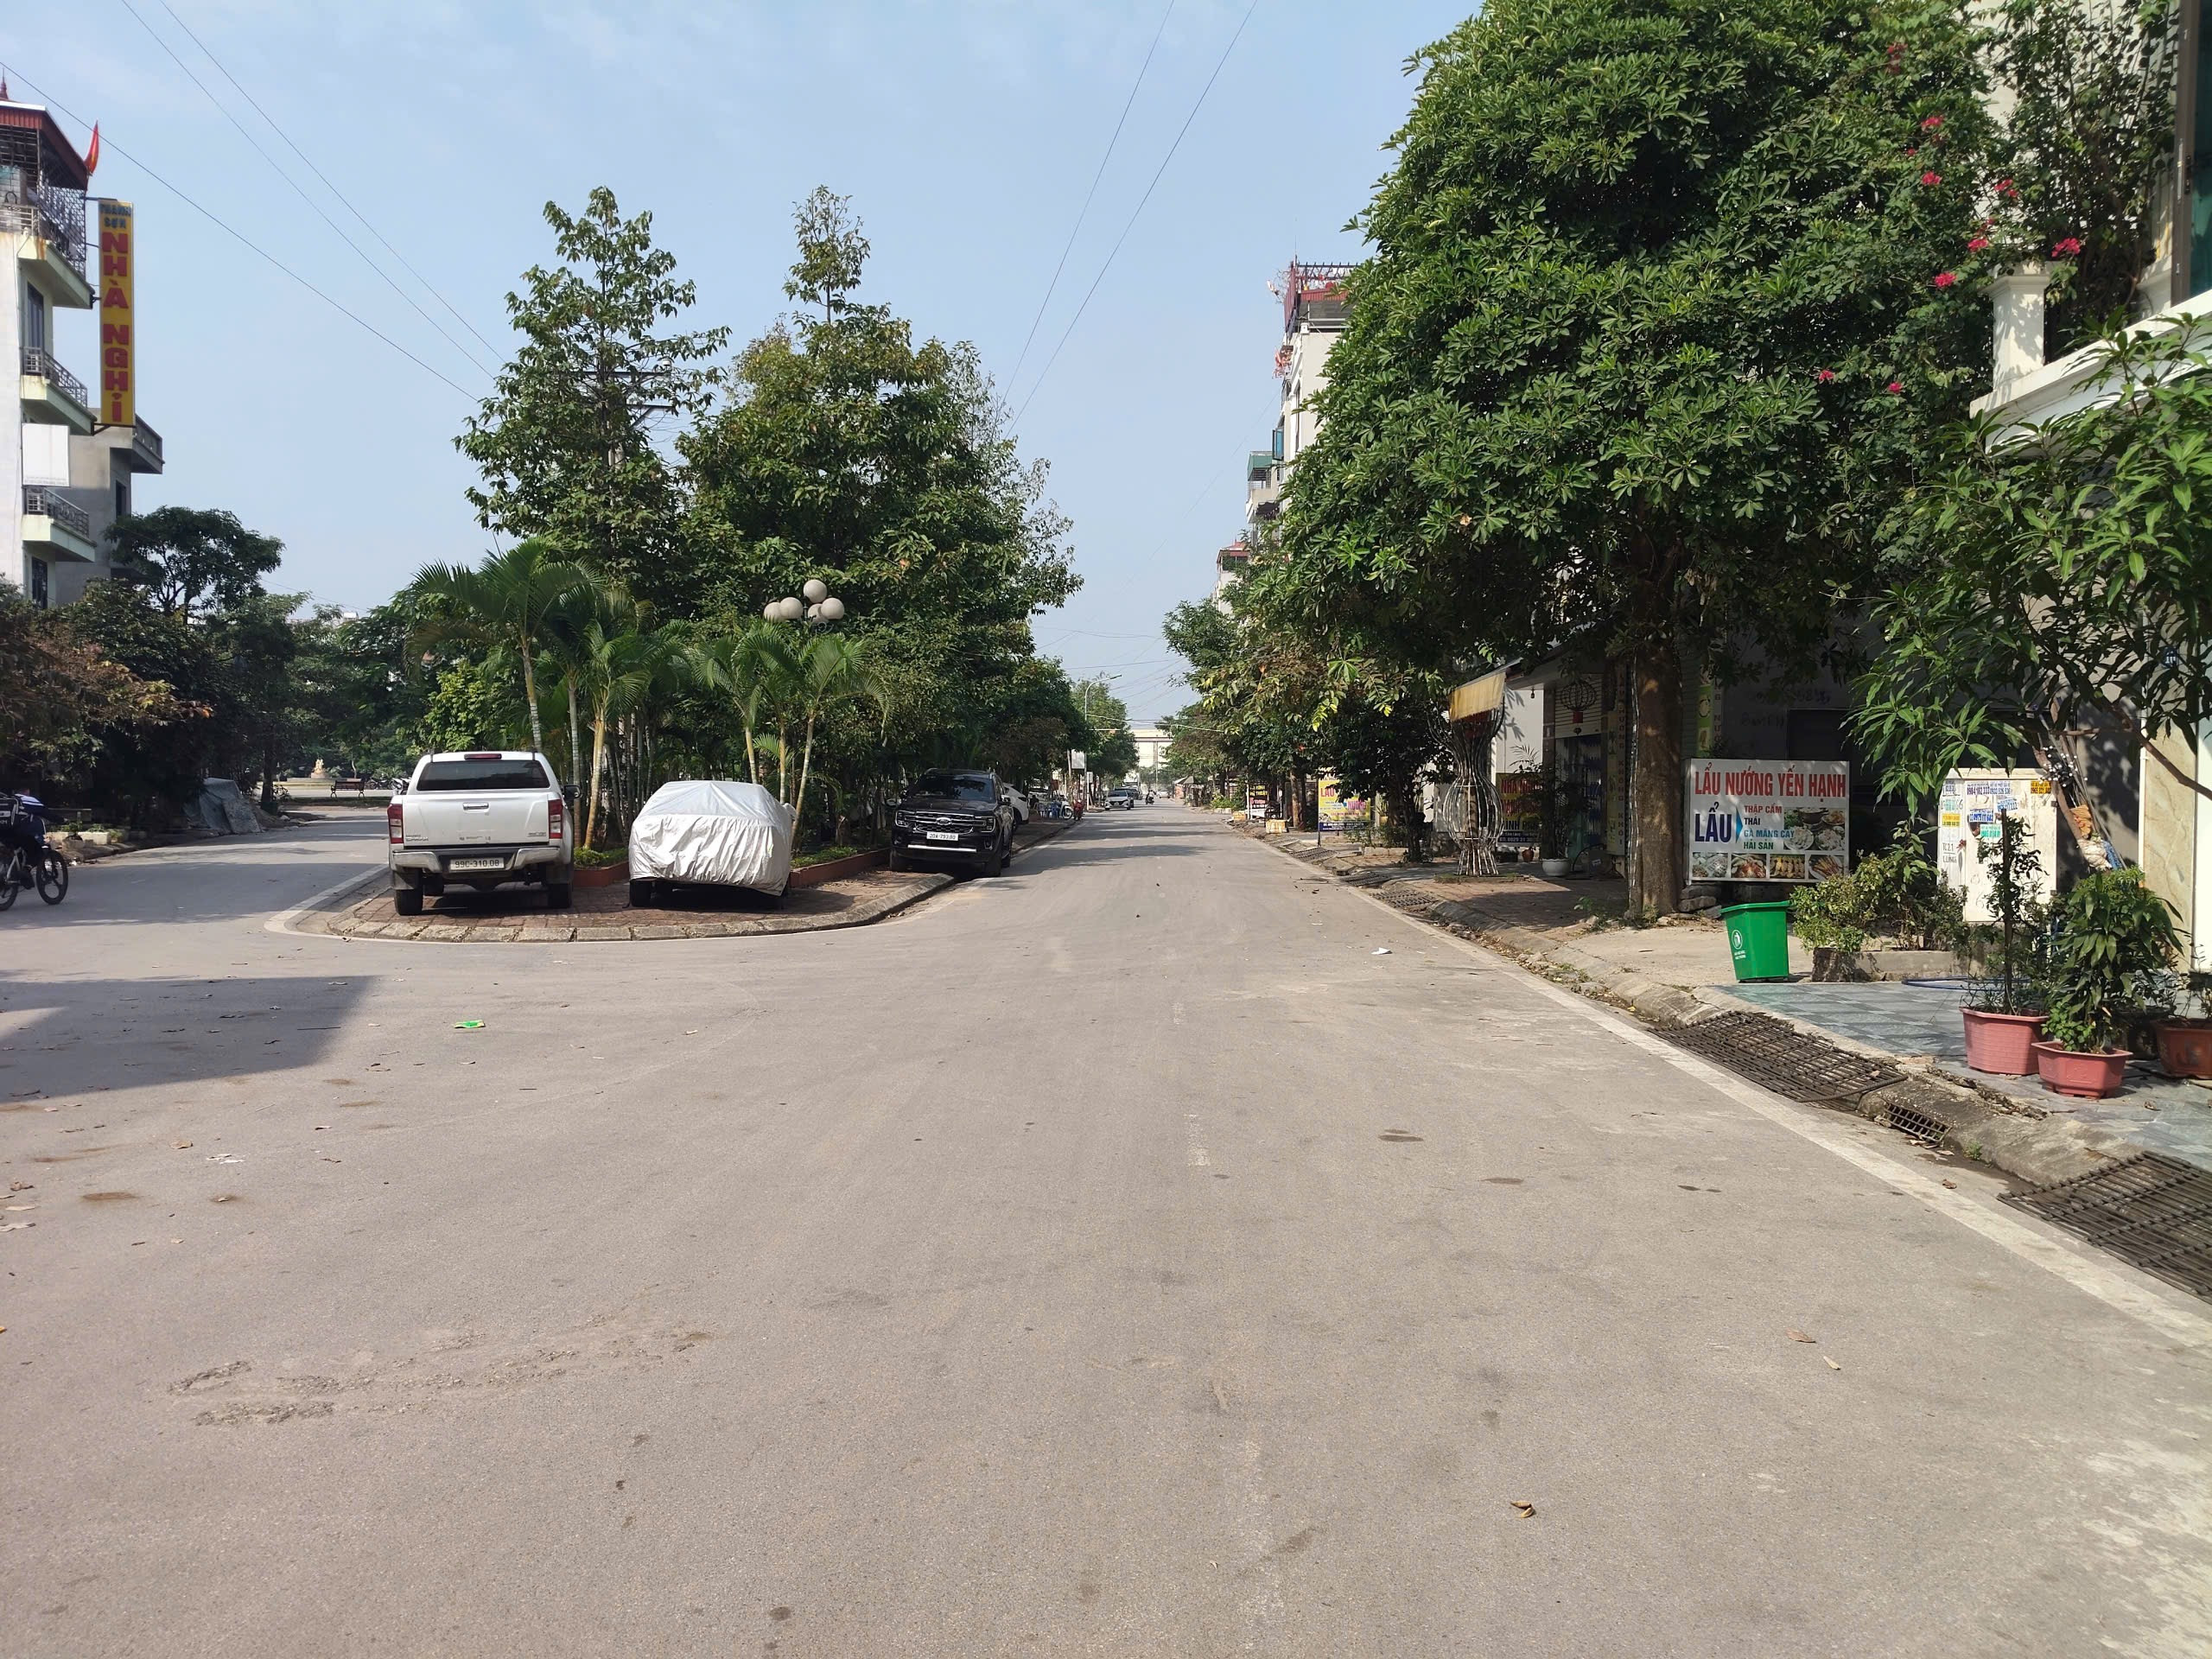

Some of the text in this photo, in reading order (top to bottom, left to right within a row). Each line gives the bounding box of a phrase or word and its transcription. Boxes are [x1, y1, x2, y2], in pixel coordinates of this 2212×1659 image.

[102, 232, 129, 309] NHÀ
[1694, 762, 1847, 802] LẨU NƯỚNG YẾN HẠNH
[1694, 802, 1732, 842] LẨU
[1744, 817, 1761, 825] THÁI
